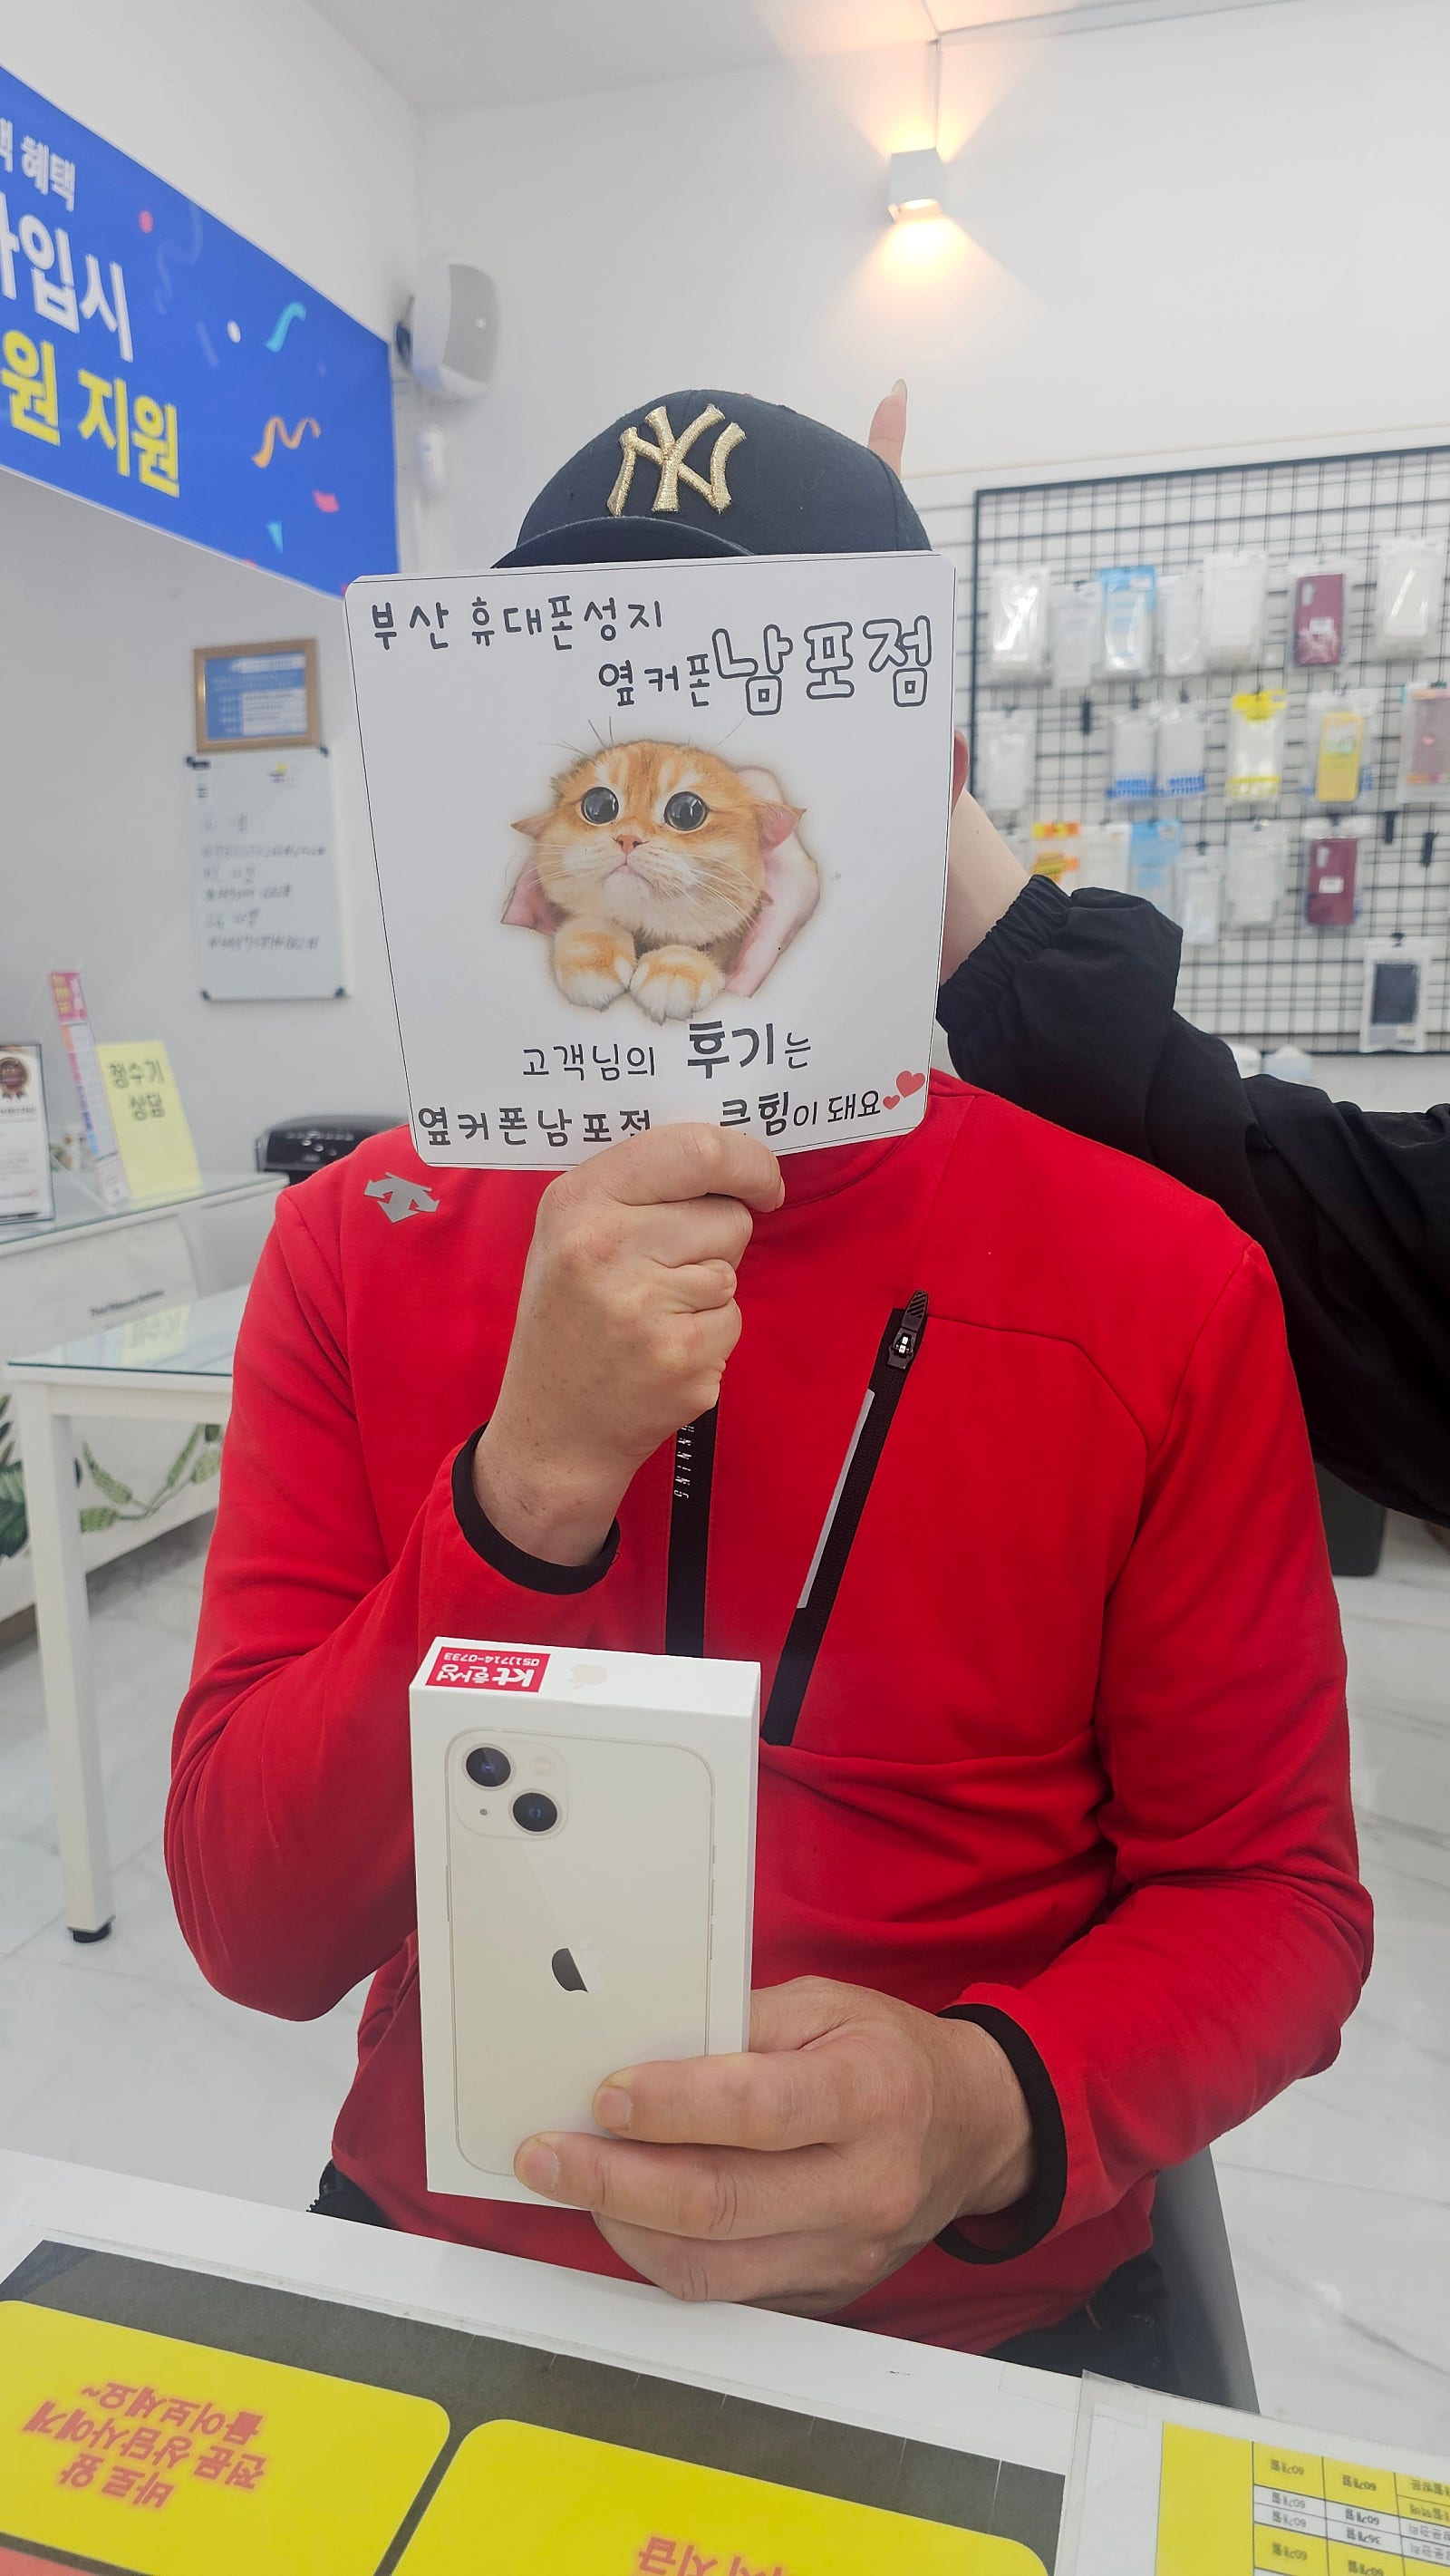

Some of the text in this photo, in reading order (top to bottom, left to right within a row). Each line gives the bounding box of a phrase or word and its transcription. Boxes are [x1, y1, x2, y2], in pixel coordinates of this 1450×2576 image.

[20, 133, 76, 213] 혜택
[77, 368, 180, 499] 지원
[605, 402, 748, 518] NY
[371, 595, 663, 651] 부산 휴대폰성지
[522, 1020, 812, 1080] 고객님의 후기는
[130, 1093, 165, 1121] 상담
[826, 1089, 882, 1124] 돼요
[443, 1651, 541, 1667] 051)714-0733
[80, 2381, 264, 2447] 물어보세요~
[23, 2399, 267, 2491] 전문 상담사에게
[58, 2453, 175, 2509] 바로 앞
